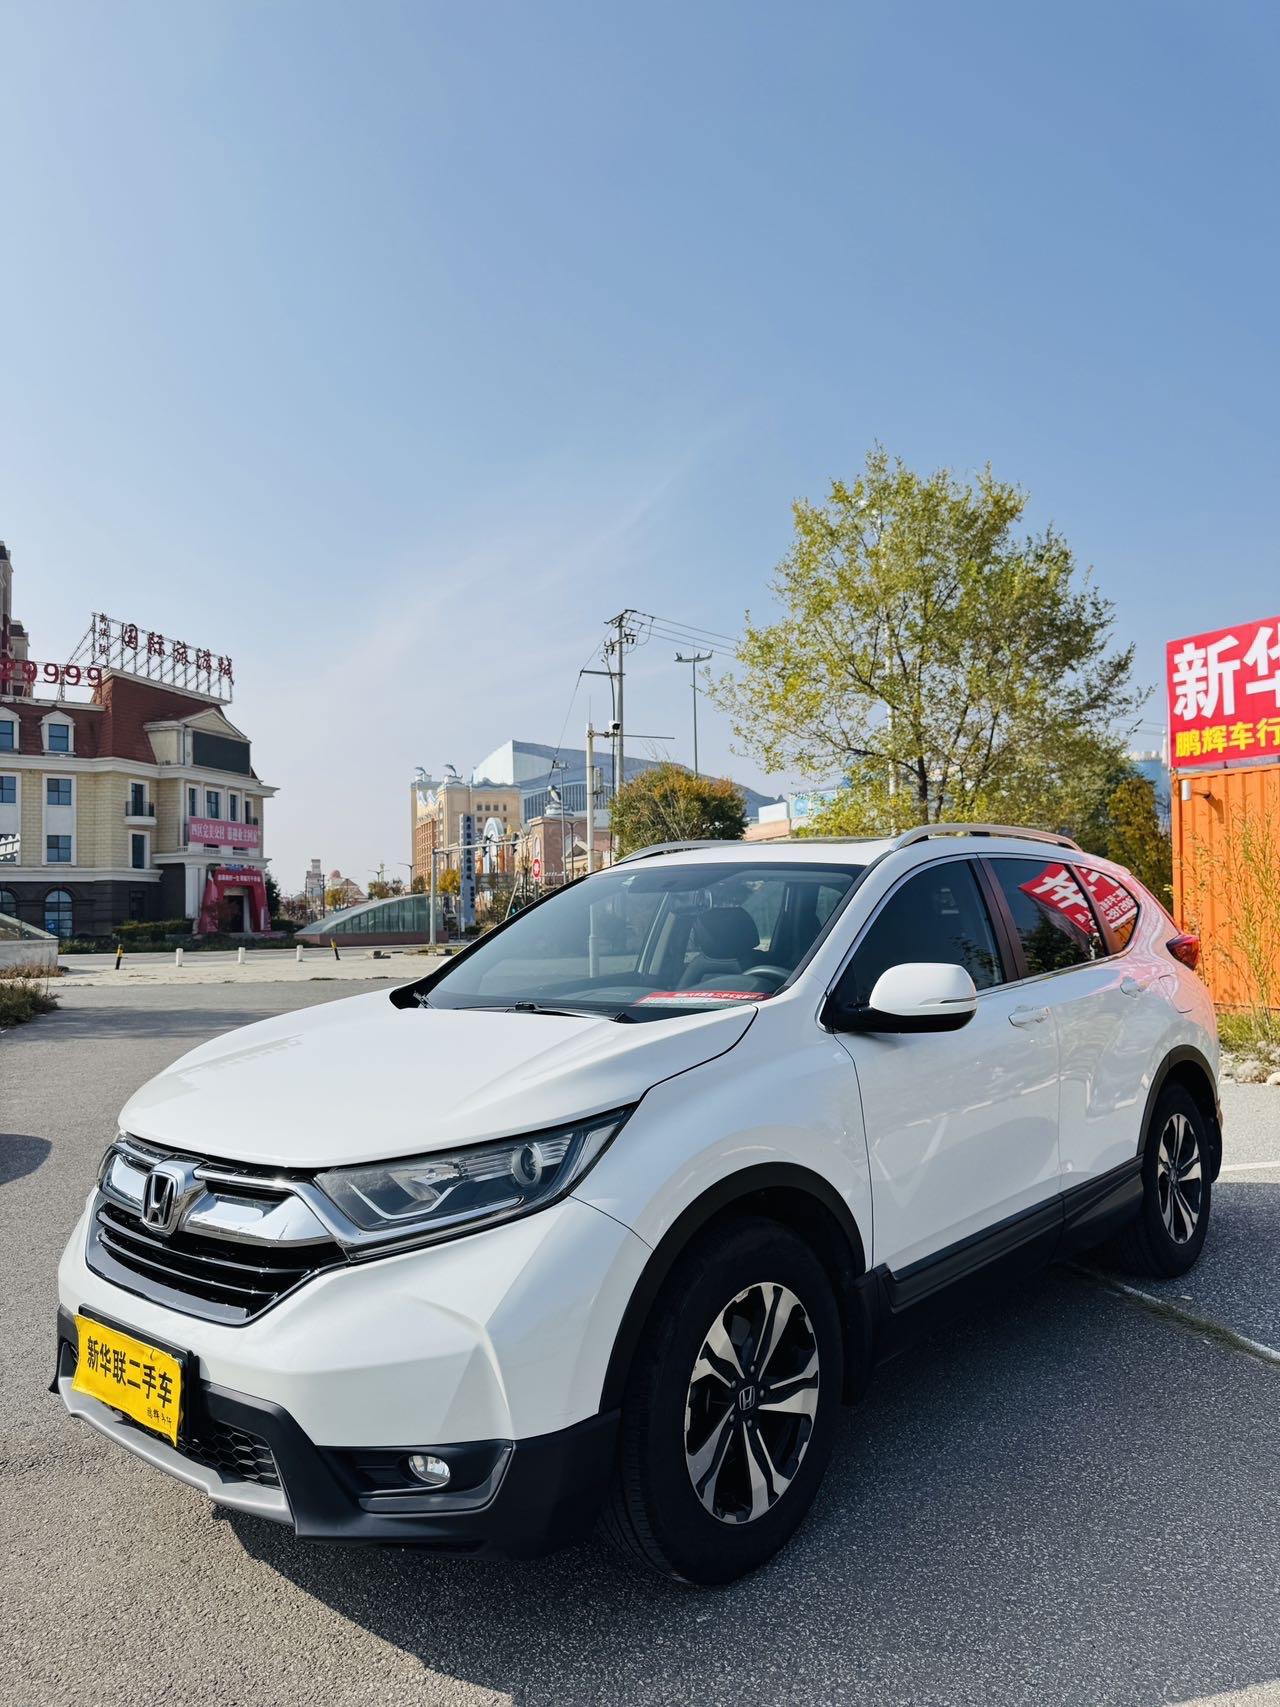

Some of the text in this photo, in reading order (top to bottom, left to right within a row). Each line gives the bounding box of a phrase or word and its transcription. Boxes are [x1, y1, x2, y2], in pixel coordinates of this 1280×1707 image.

[1175, 717, 1280, 758] 鹏辉车行
[87, 1335, 173, 1409] 新华联二手车
